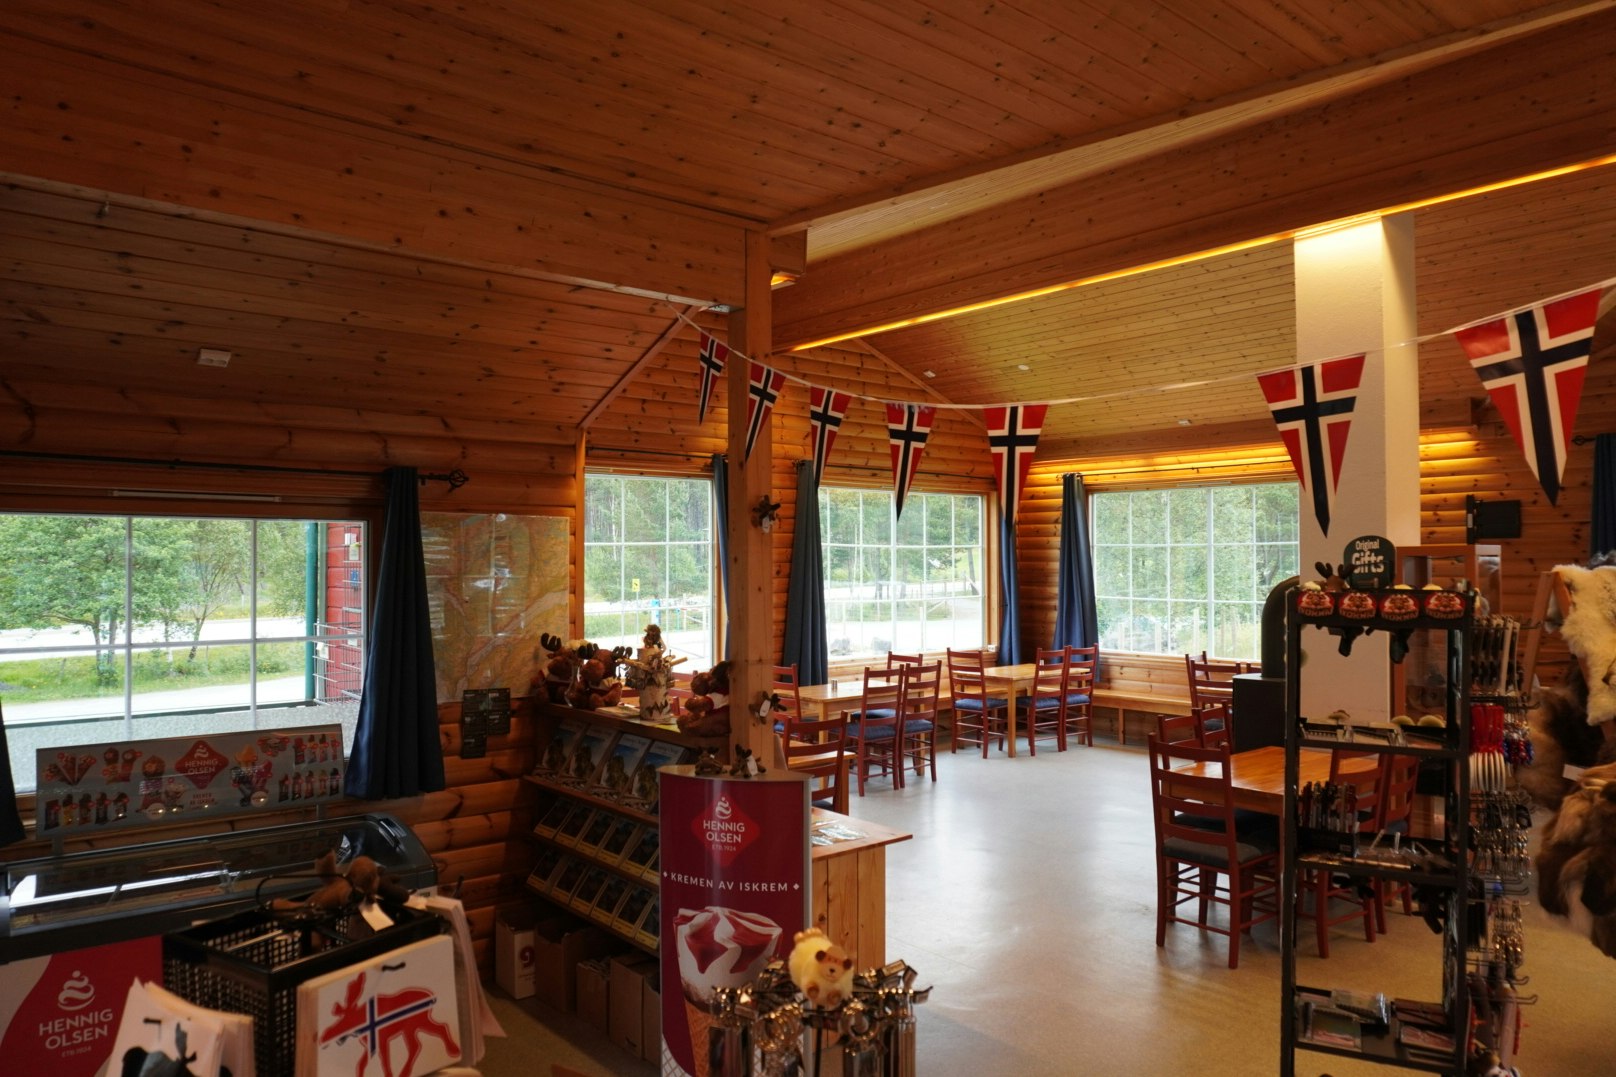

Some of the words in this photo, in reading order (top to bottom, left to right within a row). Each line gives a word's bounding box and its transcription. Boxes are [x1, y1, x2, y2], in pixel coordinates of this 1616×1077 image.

[1355, 538, 1380, 550] Original
[1351, 551, 1385, 574] Gifts
[185, 759, 218, 767] HENNIG
[703, 820, 745, 832] HENNIG
[706, 833, 741, 843] OLSEN
[670, 872, 713, 889] KREMEN
[718, 880, 734, 891] AV
[739, 882, 788, 892] ISKREM
[39, 1008, 113, 1036] HENNIG
[45, 1024, 108, 1050] OLSEN
